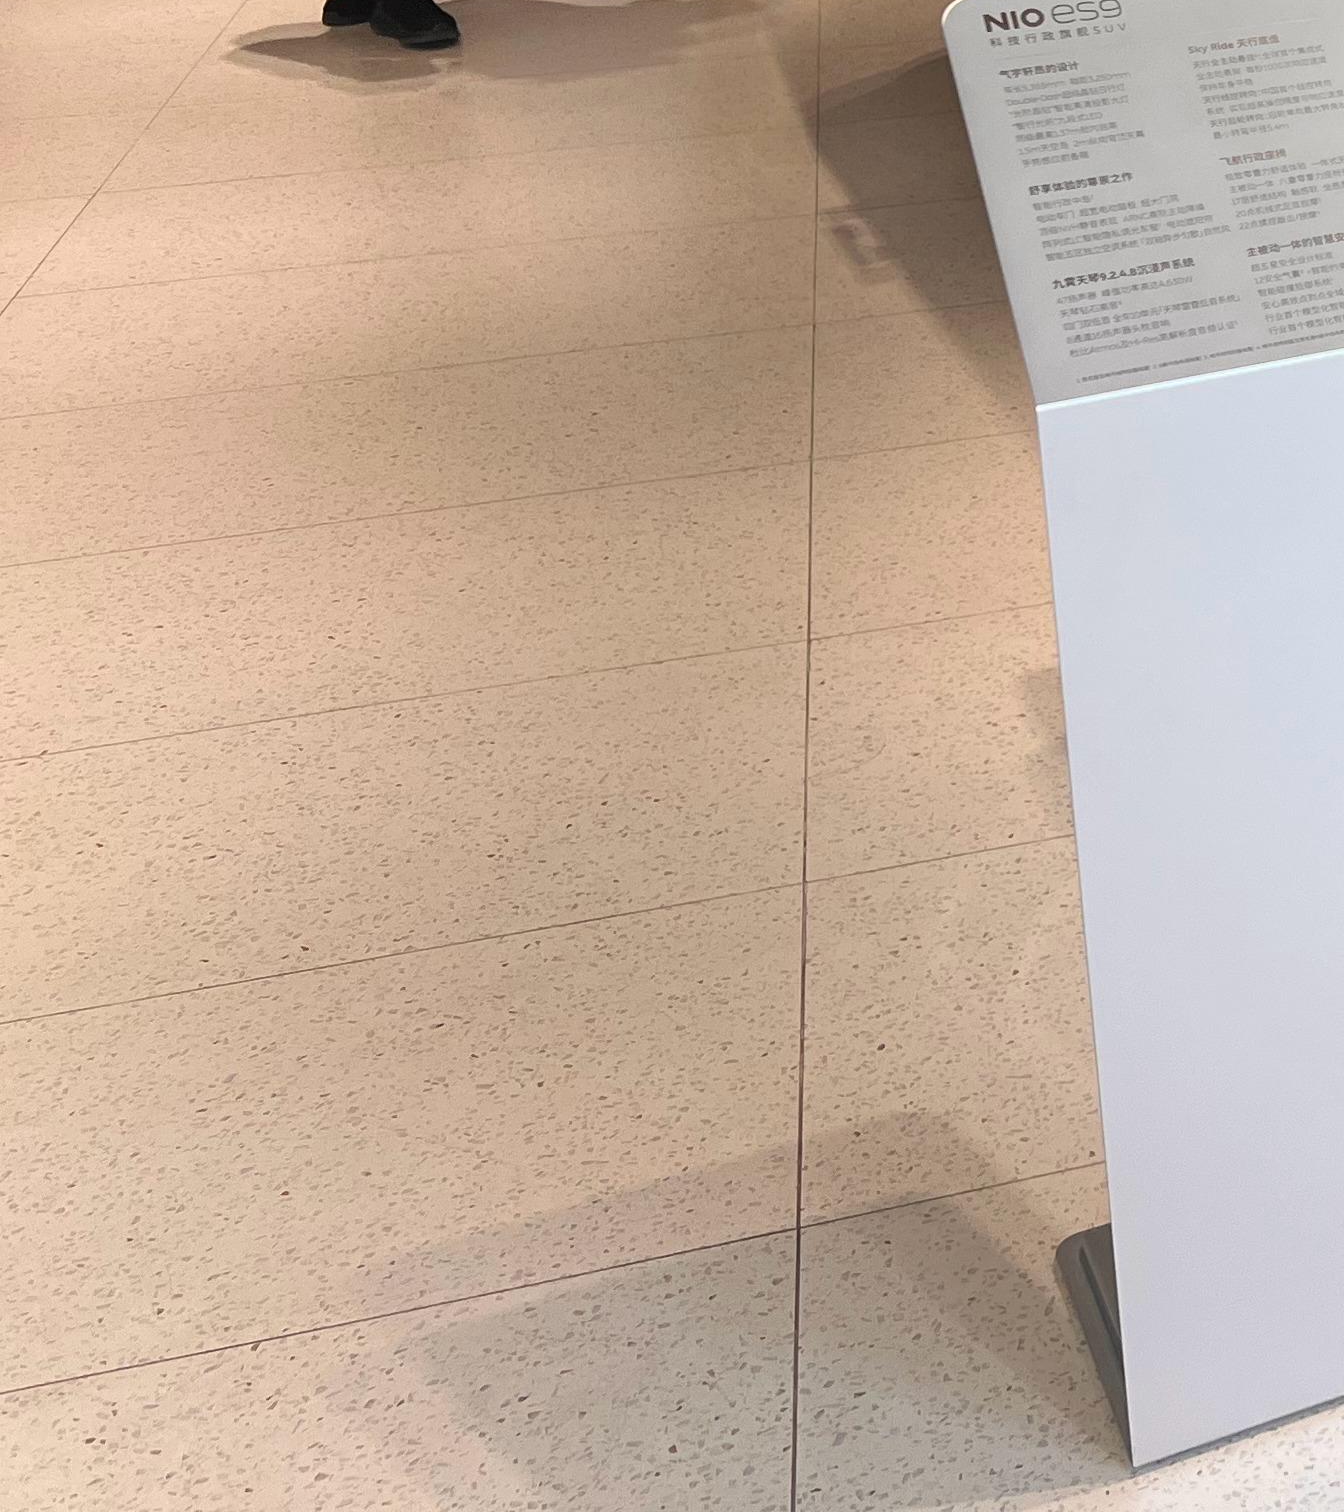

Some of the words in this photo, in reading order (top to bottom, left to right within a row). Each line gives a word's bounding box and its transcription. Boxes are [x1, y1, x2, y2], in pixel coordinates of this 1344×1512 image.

[982, 7, 1045, 33] NIO
[1188, 45, 1208, 55] Sky
[1210, 42, 1234, 52] Ride
